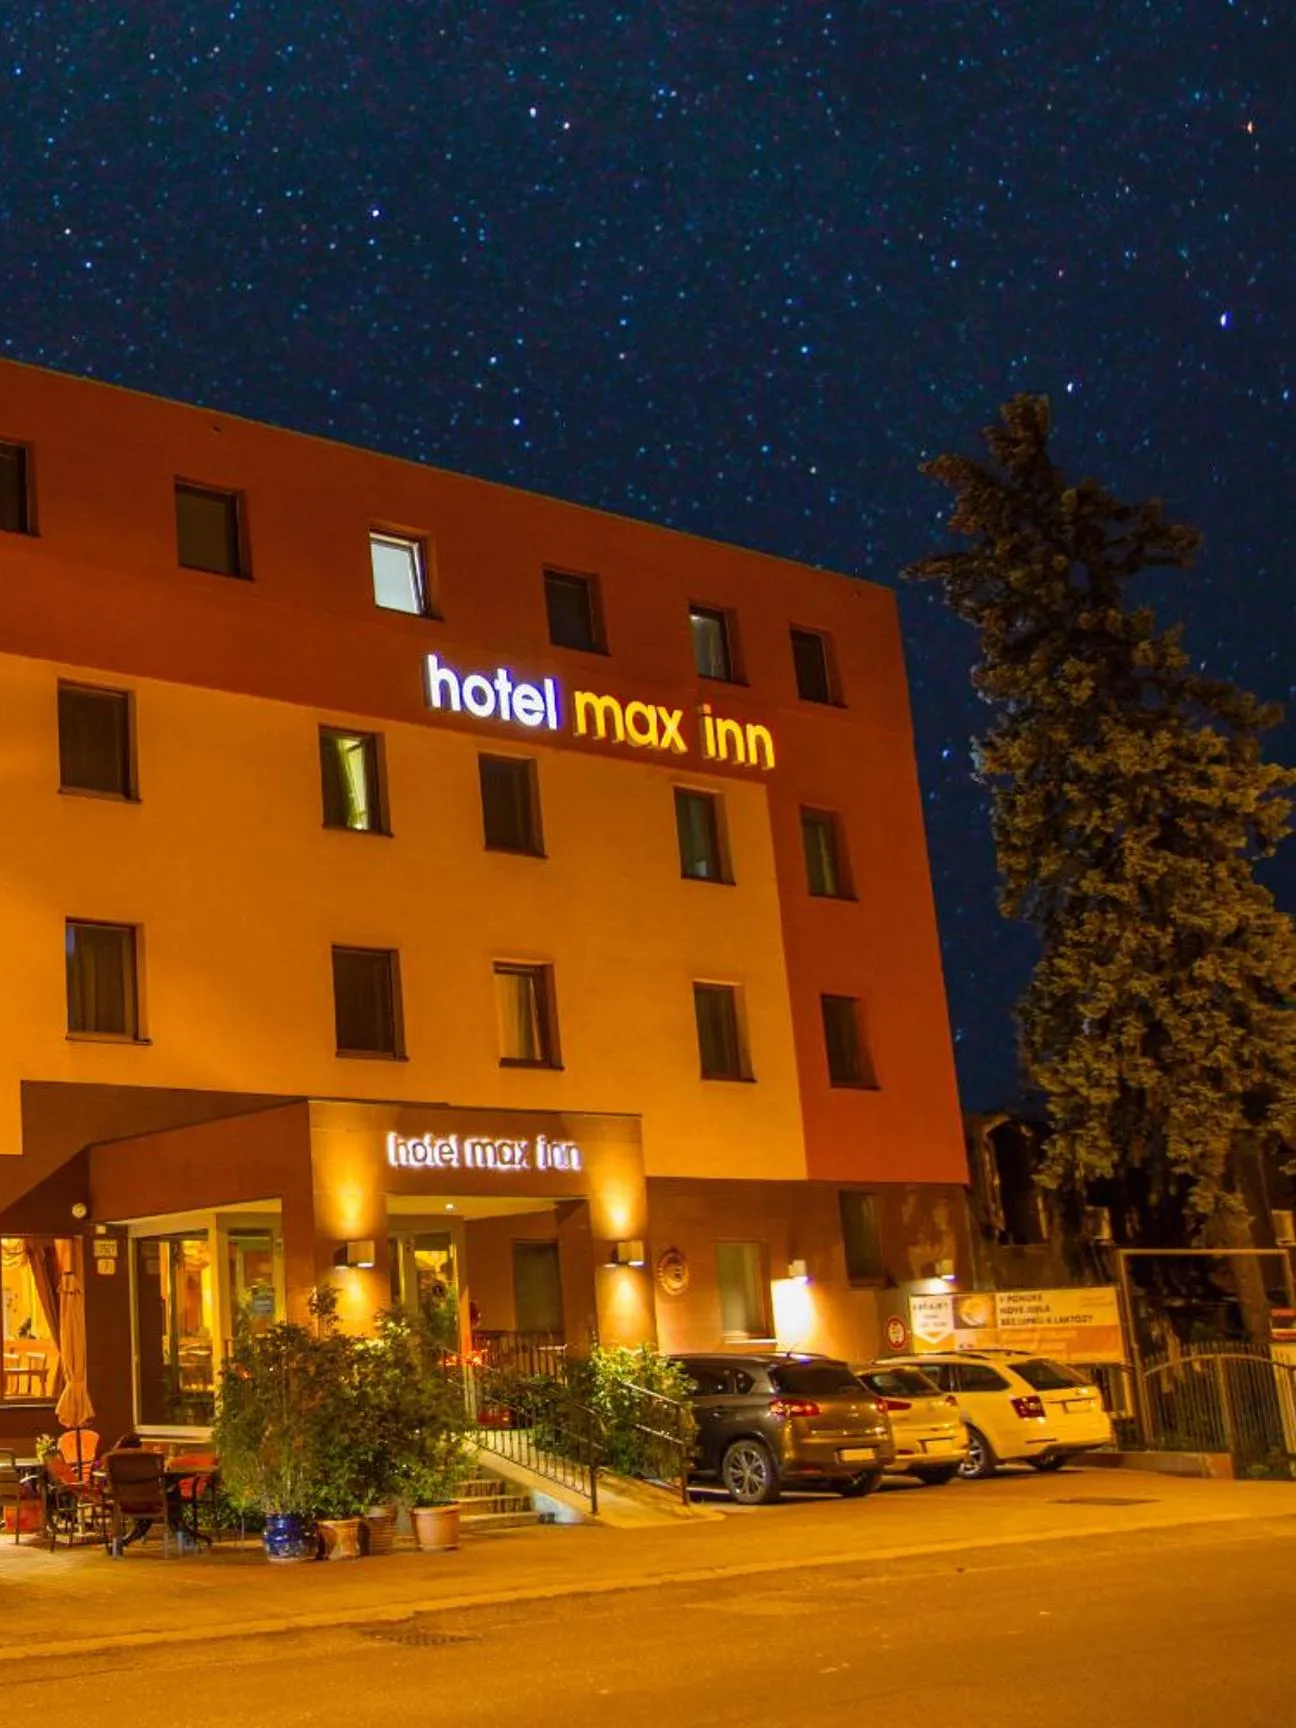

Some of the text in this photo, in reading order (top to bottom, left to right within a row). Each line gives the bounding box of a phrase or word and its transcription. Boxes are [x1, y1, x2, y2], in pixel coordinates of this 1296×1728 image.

[426, 653, 776, 769] hotel max inn
[386, 1131, 458, 1168] hotel
[463, 1137, 531, 1171] max
